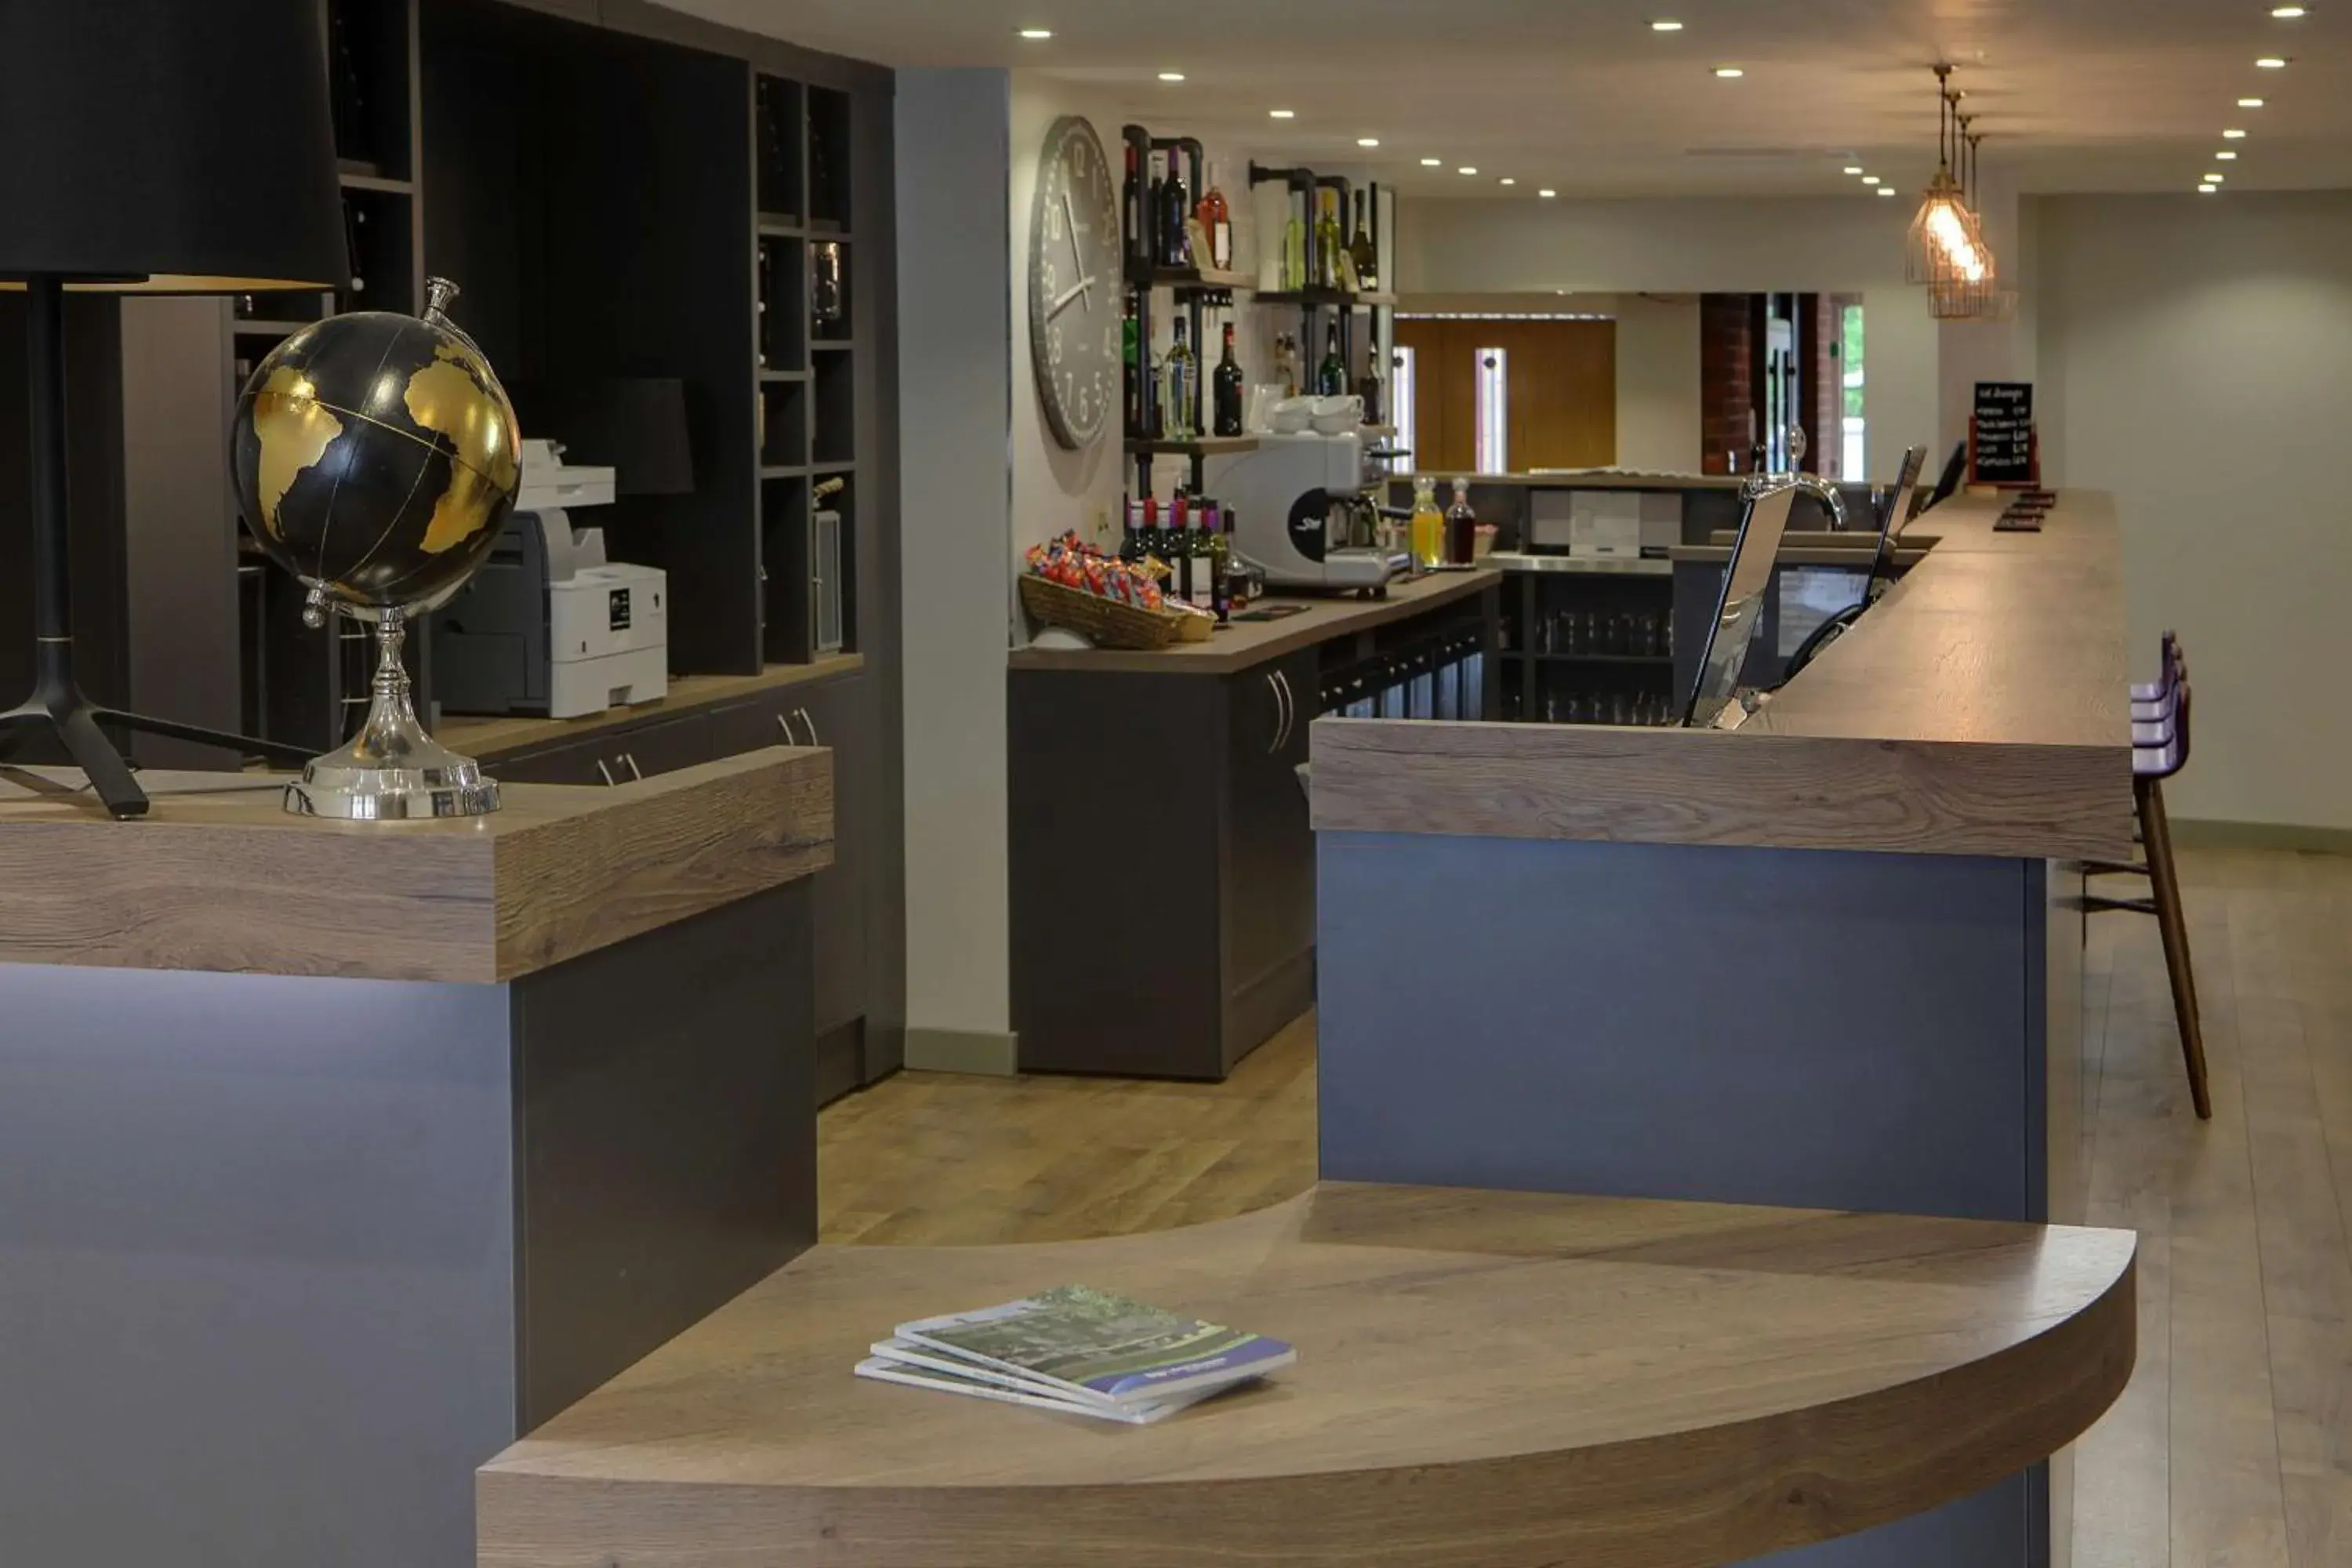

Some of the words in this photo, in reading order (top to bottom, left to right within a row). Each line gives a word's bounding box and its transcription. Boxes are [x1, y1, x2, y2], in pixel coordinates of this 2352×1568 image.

[1054, 325, 1062, 365] 8
[1065, 371, 1074, 408] 7
[1080, 386, 1089, 424] 6
[1094, 371, 1103, 405] 5
